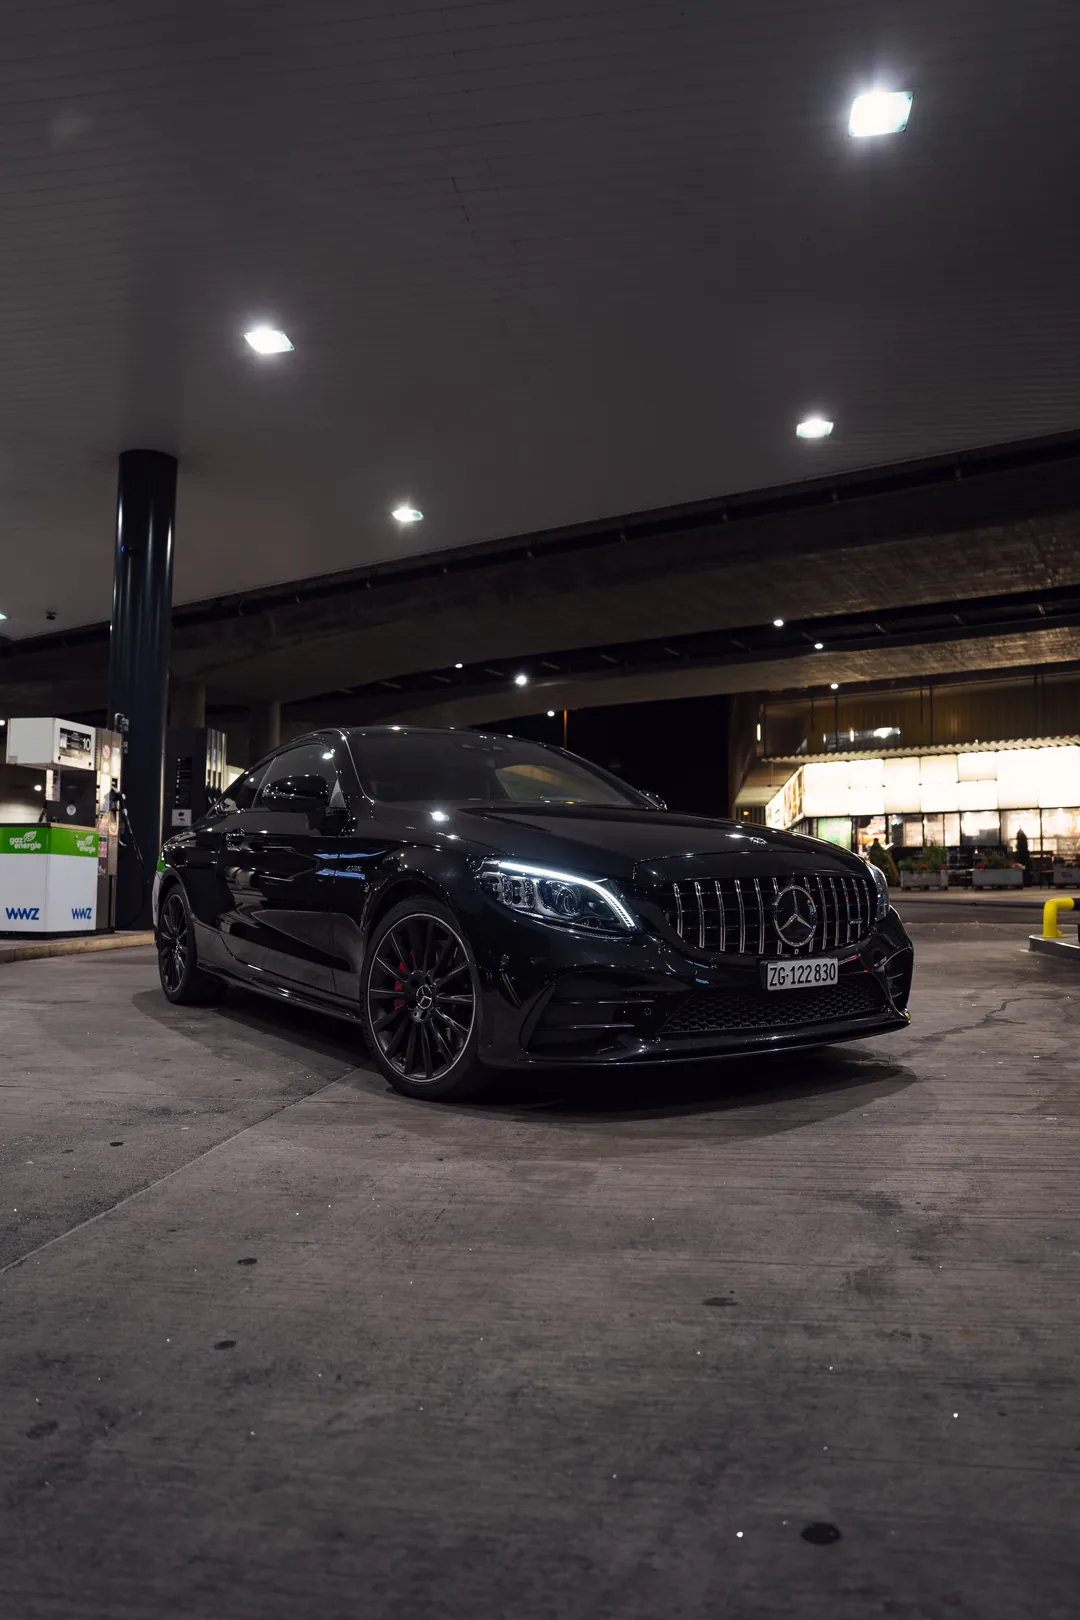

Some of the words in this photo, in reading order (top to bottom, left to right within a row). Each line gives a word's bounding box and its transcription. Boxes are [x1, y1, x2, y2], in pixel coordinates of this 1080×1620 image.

[82, 737, 91, 751] 10
[9, 837, 23, 846] gaz
[14, 842, 42, 851] energie
[5, 907, 40, 921] WWZ
[71, 907, 92, 920] WWZ
